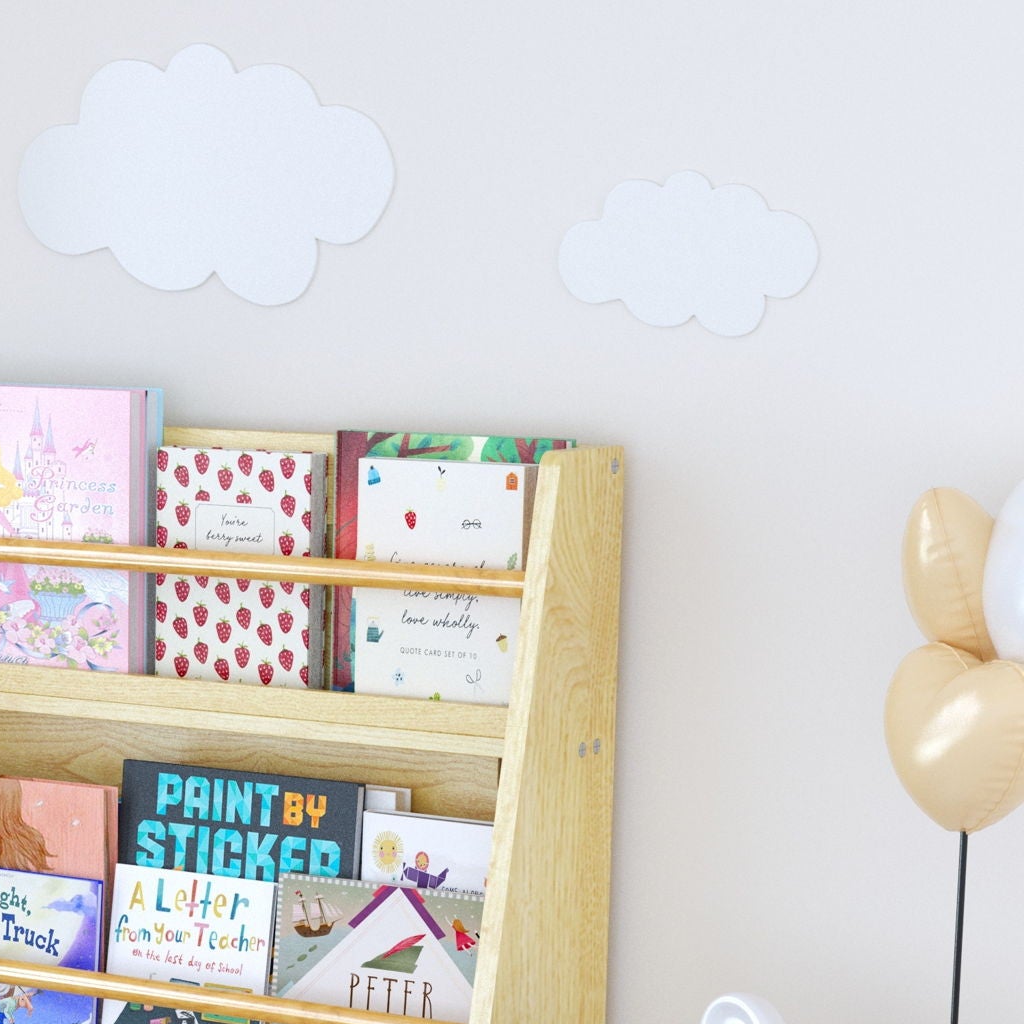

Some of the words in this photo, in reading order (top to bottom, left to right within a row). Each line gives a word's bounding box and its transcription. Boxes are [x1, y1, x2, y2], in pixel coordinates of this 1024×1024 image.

[28, 466, 116, 493] Princess
[30, 495, 114, 522] Garden
[206, 530, 233, 547] berry
[235, 532, 263, 543] sweet
[401, 609, 430, 625] love
[433, 612, 480, 639] wholly.
[400, 646, 421, 656] QUOTE
[424, 648, 442, 657] CARD
[444, 650, 455, 658] SET
[457, 651, 466, 659] OF
[469, 652, 478, 660] 10
[156, 772, 279, 827] PAINT
[283, 791, 327, 829] BY
[128, 881, 145, 910] A
[155, 878, 250, 920] Letter
[1, 912, 60, 957] Truck
[114, 914, 151, 943] from
[194, 922, 265, 952] Teacher
[146, 949, 161, 962] the
[164, 951, 183, 965] last
[188, 956, 202, 972] day
[205, 962, 216, 974] of
